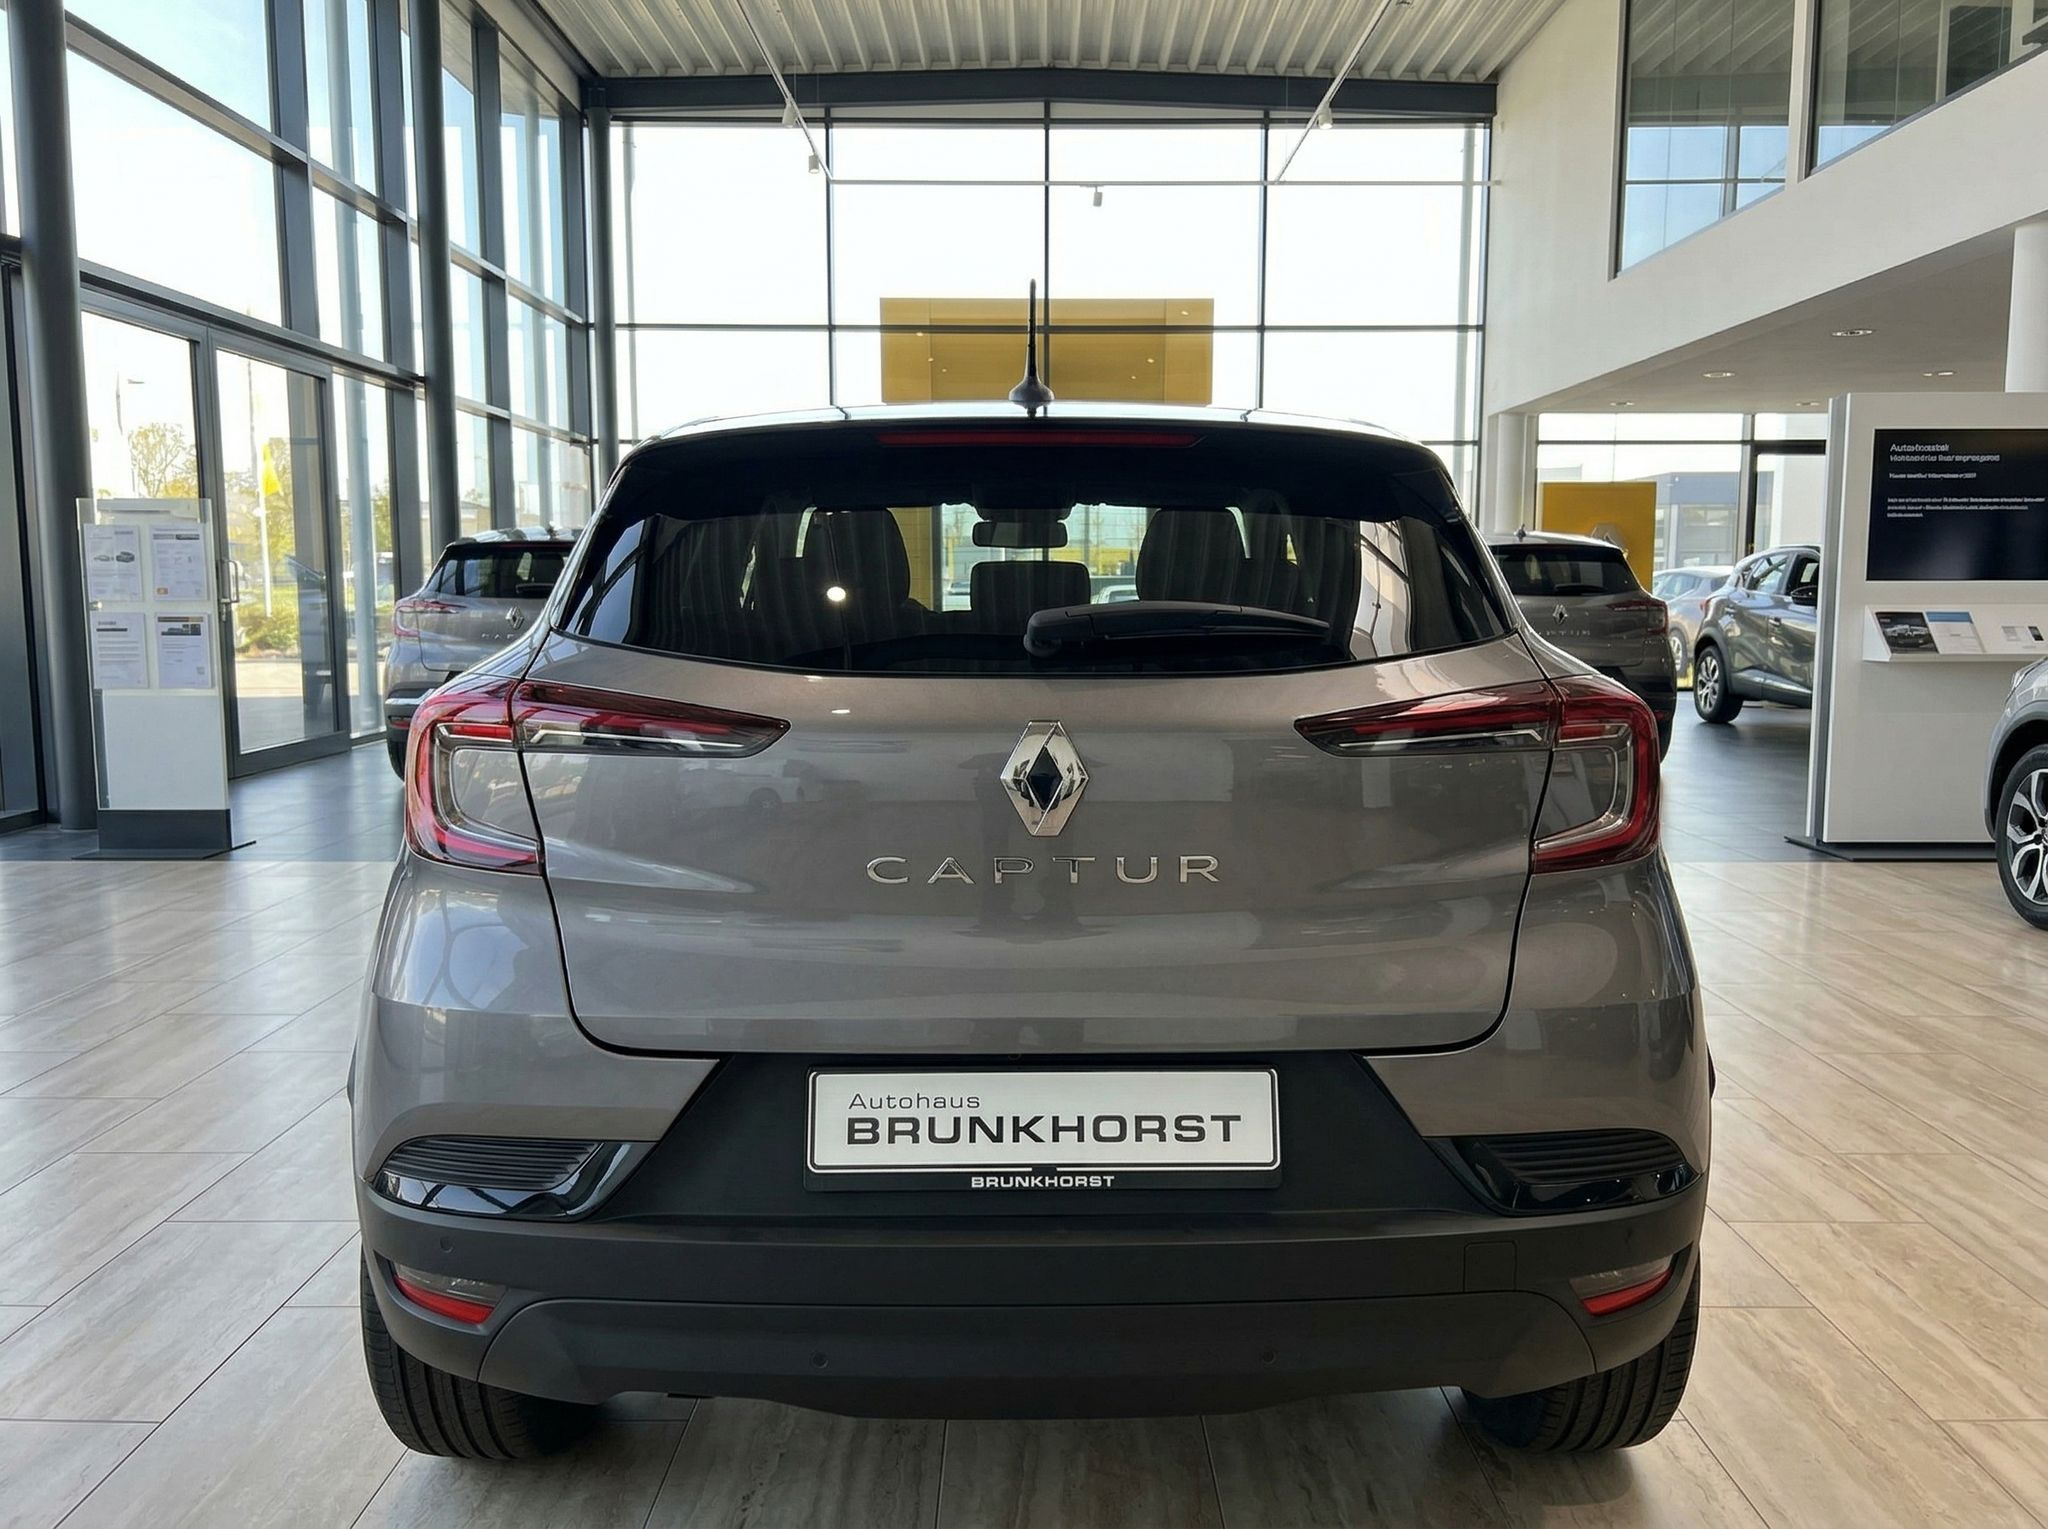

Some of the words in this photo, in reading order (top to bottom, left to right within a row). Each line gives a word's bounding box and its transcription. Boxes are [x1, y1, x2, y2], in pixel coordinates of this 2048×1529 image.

[866, 856, 1220, 884] CAPTUR
[848, 1092, 980, 1110] Autohaus
[847, 1114, 1242, 1145] BRUNKHORST
[971, 1175, 1115, 1189] BRUNKHORST
